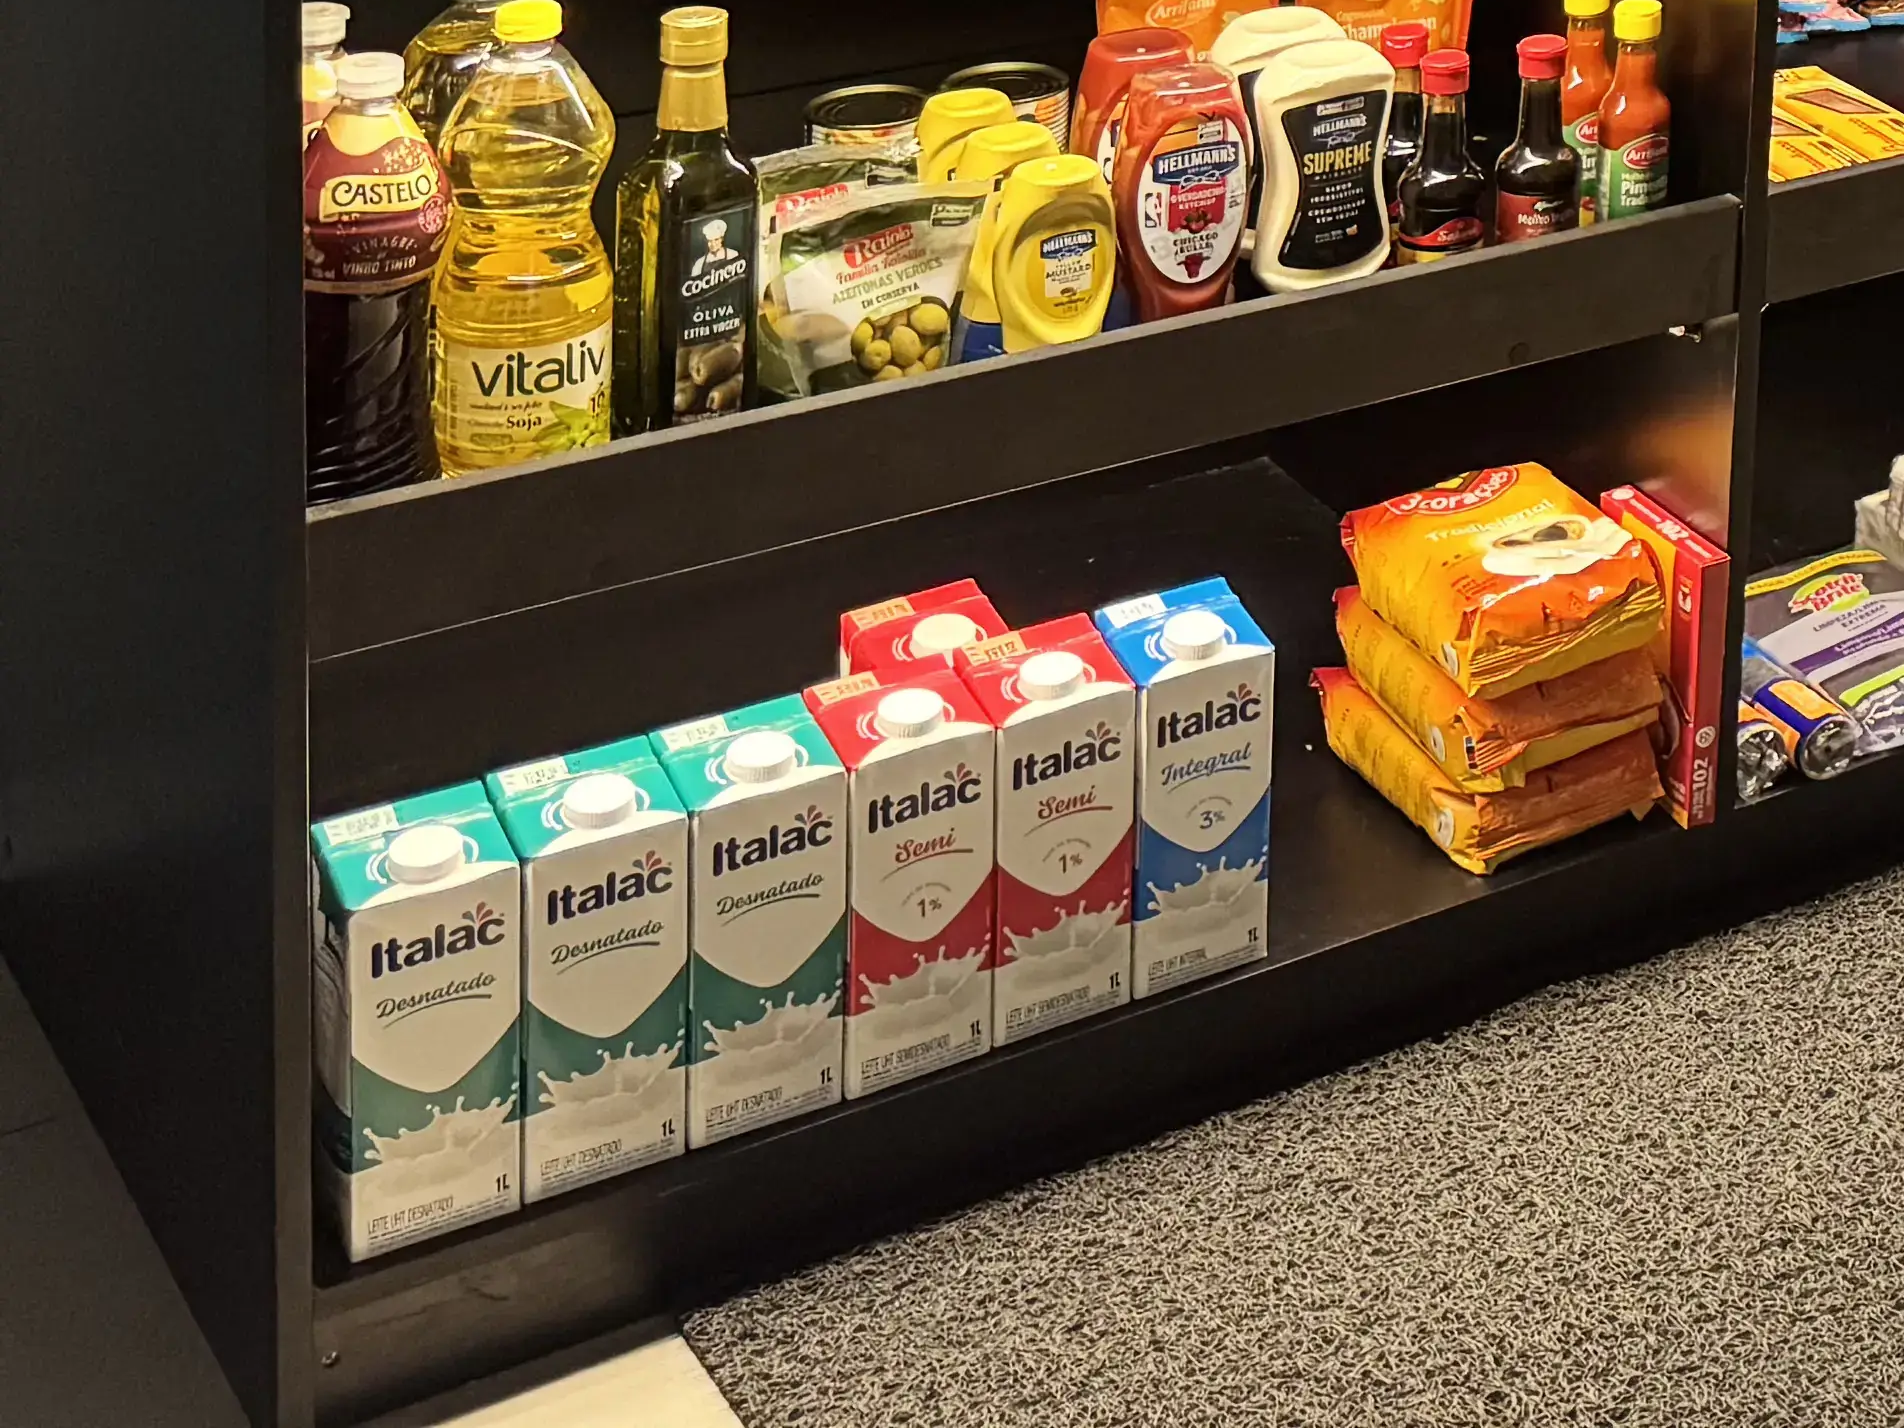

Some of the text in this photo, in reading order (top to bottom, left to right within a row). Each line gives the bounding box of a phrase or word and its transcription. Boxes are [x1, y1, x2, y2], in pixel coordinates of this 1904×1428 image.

[1312, 114, 1368, 137] HELLMANN'S
[1158, 145, 1237, 175] HELLMANN'S
[1303, 141, 1373, 176] SUPREME
[331, 174, 432, 207] CASTELO
[1173, 232, 1218, 247] CHICAGO
[384, 256, 417, 271] TINTO
[681, 258, 747, 297] Cocinero
[832, 257, 944, 305] AZEITONAS VERDES
[1045, 263, 1092, 280] MUSTARD
[875, 282, 920, 304] CONSERVA
[471, 340, 606, 398] vitaliv
[506, 414, 542, 431] Soja
[1424, 499, 1555, 543] Tradicional
[1156, 696, 1261, 748] Italac
[1012, 734, 1122, 790] Italac
[1160, 742, 1252, 787] Integral
[1694, 756, 1710, 791] 102
[868, 773, 982, 834] Italac
[1038, 785, 1096, 820] Semi
[1199, 808, 1226, 830] 3%
[711, 816, 835, 878] Italac
[895, 827, 956, 864] Semi
[1058, 852, 1083, 875] 1%
[546, 867, 673, 927] Italac
[716, 872, 825, 916] Desnatado
[916, 896, 943, 918] 1%
[371, 913, 506, 980] Italac
[550, 919, 665, 966] Desnatado
[1248, 927, 1259, 943] 1L
[376, 971, 497, 1019] Desnatado
[1109, 971, 1121, 989] 1L
[970, 1020, 982, 1037] 1L
[820, 1067, 833, 1085] 1L
[661, 1118, 676, 1138] 1L
[495, 1174, 509, 1193] 1L
